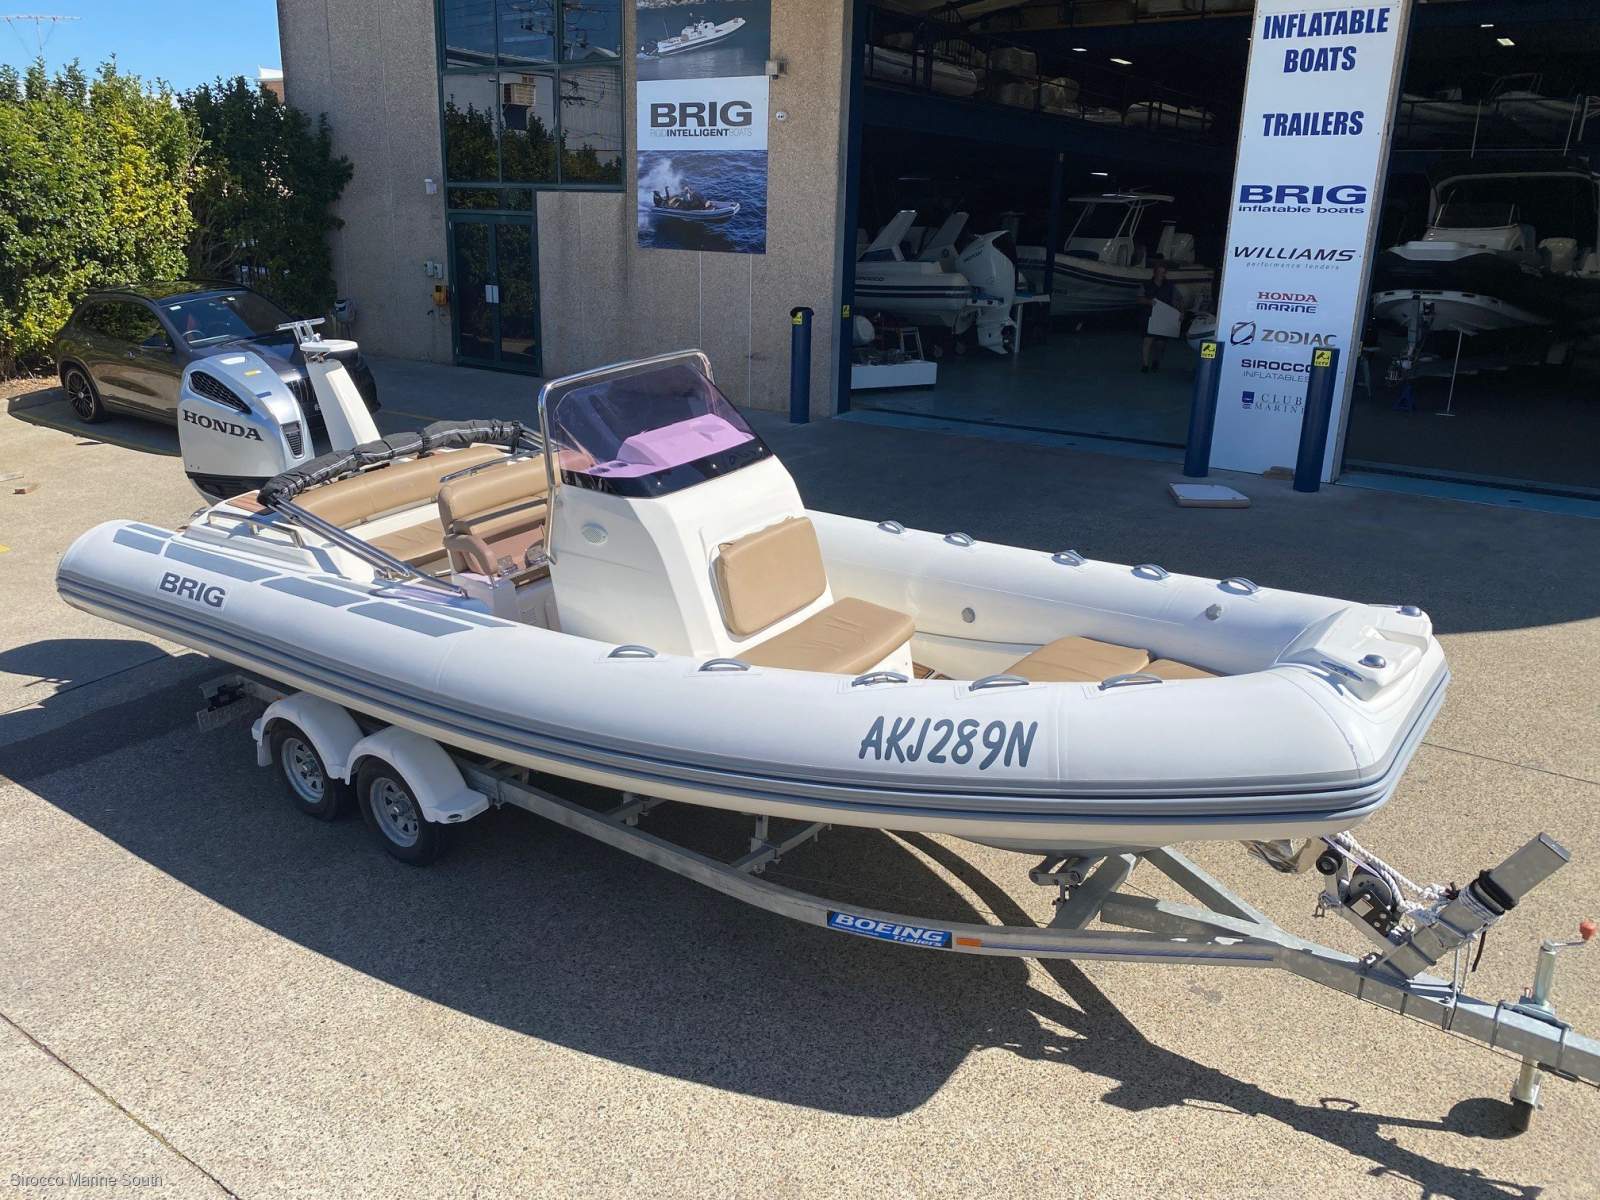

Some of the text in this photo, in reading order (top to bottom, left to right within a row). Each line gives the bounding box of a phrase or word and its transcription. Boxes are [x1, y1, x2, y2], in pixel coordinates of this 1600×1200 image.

[1263, 8, 1391, 40] INFLATABLE
[1283, 46, 1357, 73] BOATS
[650, 101, 752, 128] BRIG
[1263, 111, 1365, 137] TRAILERS
[1240, 185, 1367, 205] BRIG
[1239, 205, 1365, 214] inflatable boats
[1234, 246, 1356, 262] WILLIAMS
[1256, 291, 1318, 303] HONDA
[1261, 329, 1337, 347] ZODIAC
[1254, 402, 1304, 414] MARIN
[1261, 392, 1303, 406] CLUB
[183, 409, 264, 442] HONDA
[159, 571, 226, 608] BRIG
[858, 715, 1038, 771] AKJ289N
[835, 914, 944, 941] BOEING
[894, 935, 942, 947] Trailers
